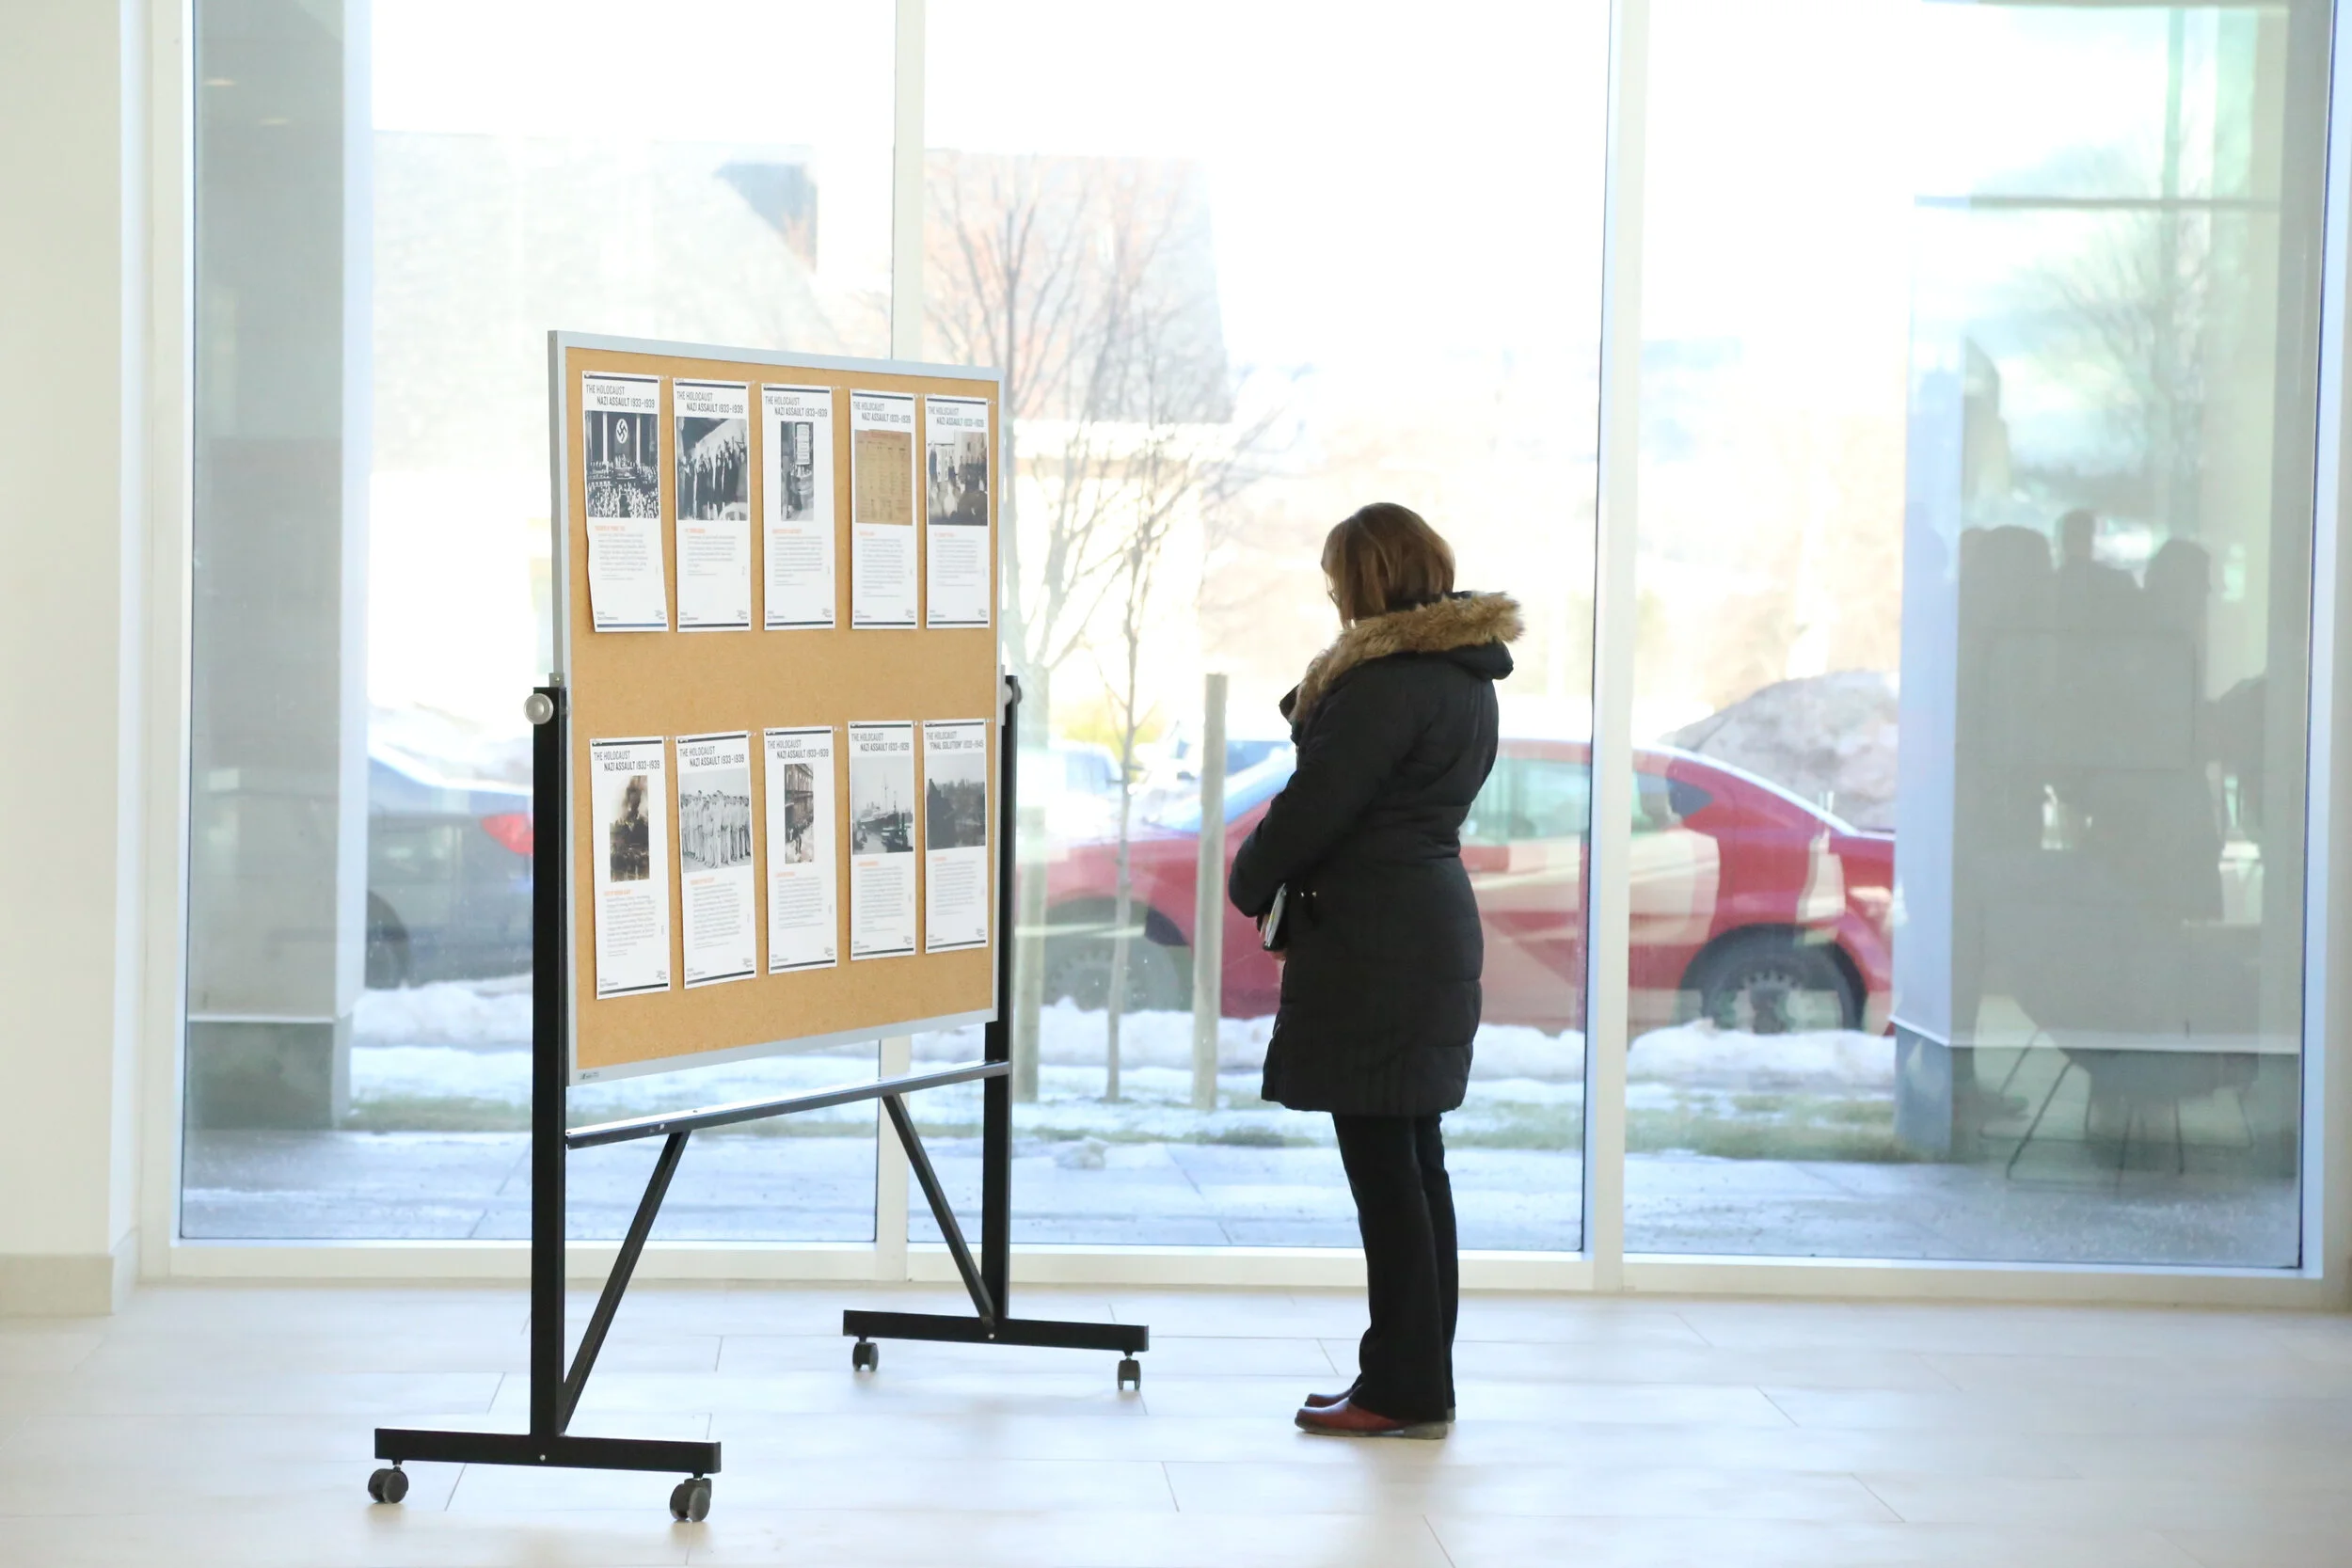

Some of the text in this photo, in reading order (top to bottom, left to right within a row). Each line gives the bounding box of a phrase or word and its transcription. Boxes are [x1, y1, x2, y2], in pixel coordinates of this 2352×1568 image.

[586, 385, 625, 394] THE HOLOCAUST
[676, 391, 712, 402] THE HOLOCAUST
[765, 396, 773, 404] THE
[597, 397, 655, 407] NAZI ASSAULT 1933-1939
[687, 403, 743, 414] NAZI ASSAULT 1933-1939
[862, 403, 884, 411] HOLOCAUST
[936, 407, 959, 416] HOLOCAUST
[775, 407, 827, 417] NAZI ASSAULT 1933-1939
[871, 413, 888, 422] ASSAULT
[946, 418, 962, 426] ASSAULT
[860, 733, 883, 741] HOLOCAUST
[934, 731, 957, 739] HOLOCAUST
[689, 746, 715, 755] HOLOCAUST
[777, 749, 829, 759] NAZI ASSAULT 1933-1939
[604, 751, 630, 760] HOLOCAUST
[690, 754, 744, 767] NAZI ASSAULT 1933-1939
[604, 760, 660, 771] NAZI ASSAULT 1933-1939
